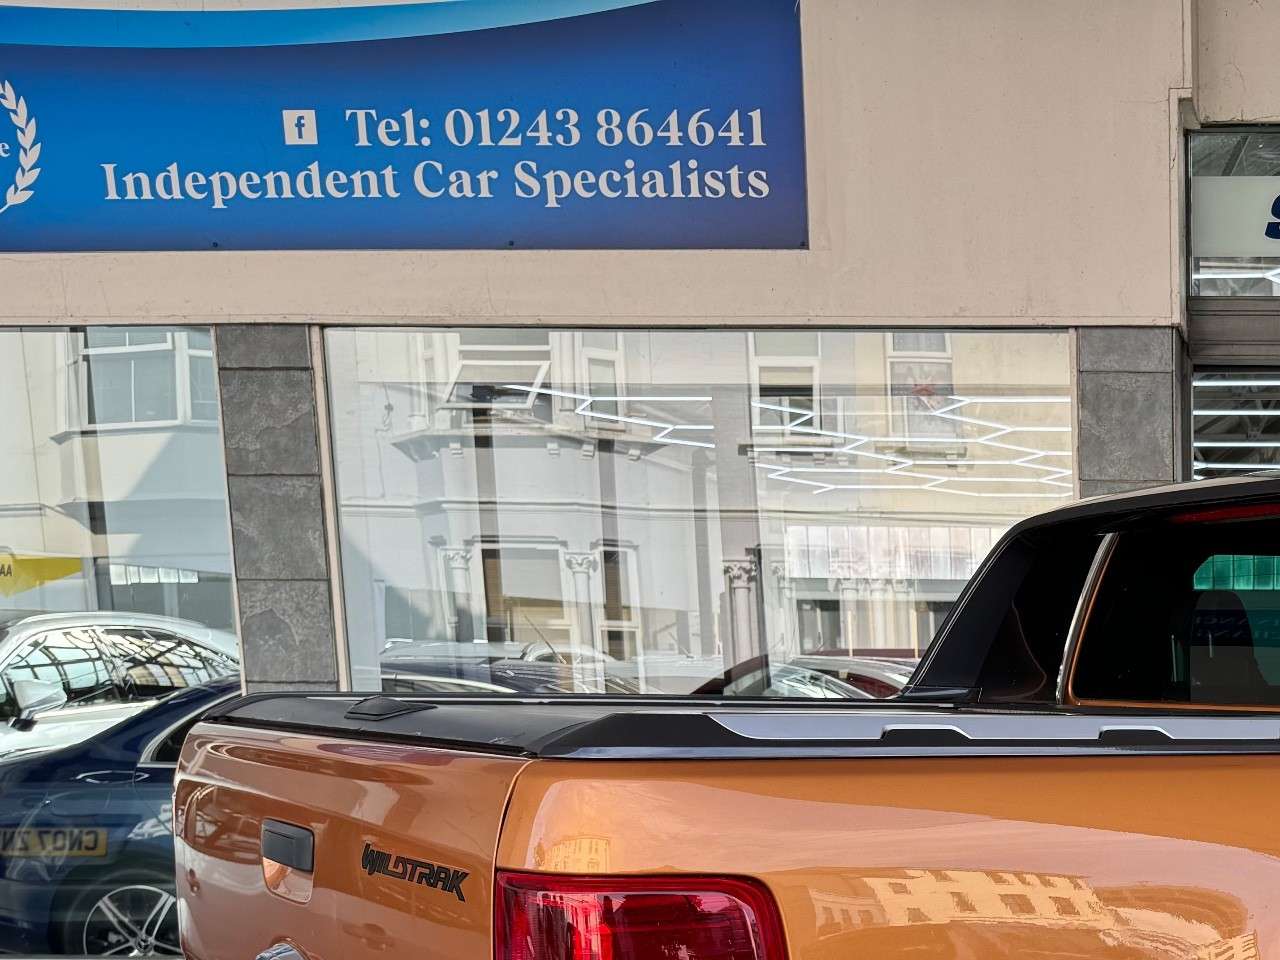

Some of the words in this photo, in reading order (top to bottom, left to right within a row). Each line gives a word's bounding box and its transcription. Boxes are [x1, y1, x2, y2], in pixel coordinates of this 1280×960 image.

[346, 108, 431, 147] Tel:
[445, 108, 581, 147] 01243
[597, 108, 767, 147] 864641
[102, 161, 400, 209] Independent
[414, 160, 498, 198] Car
[515, 159, 770, 208] Specialists
[361, 842, 470, 903] WILDTRAK
